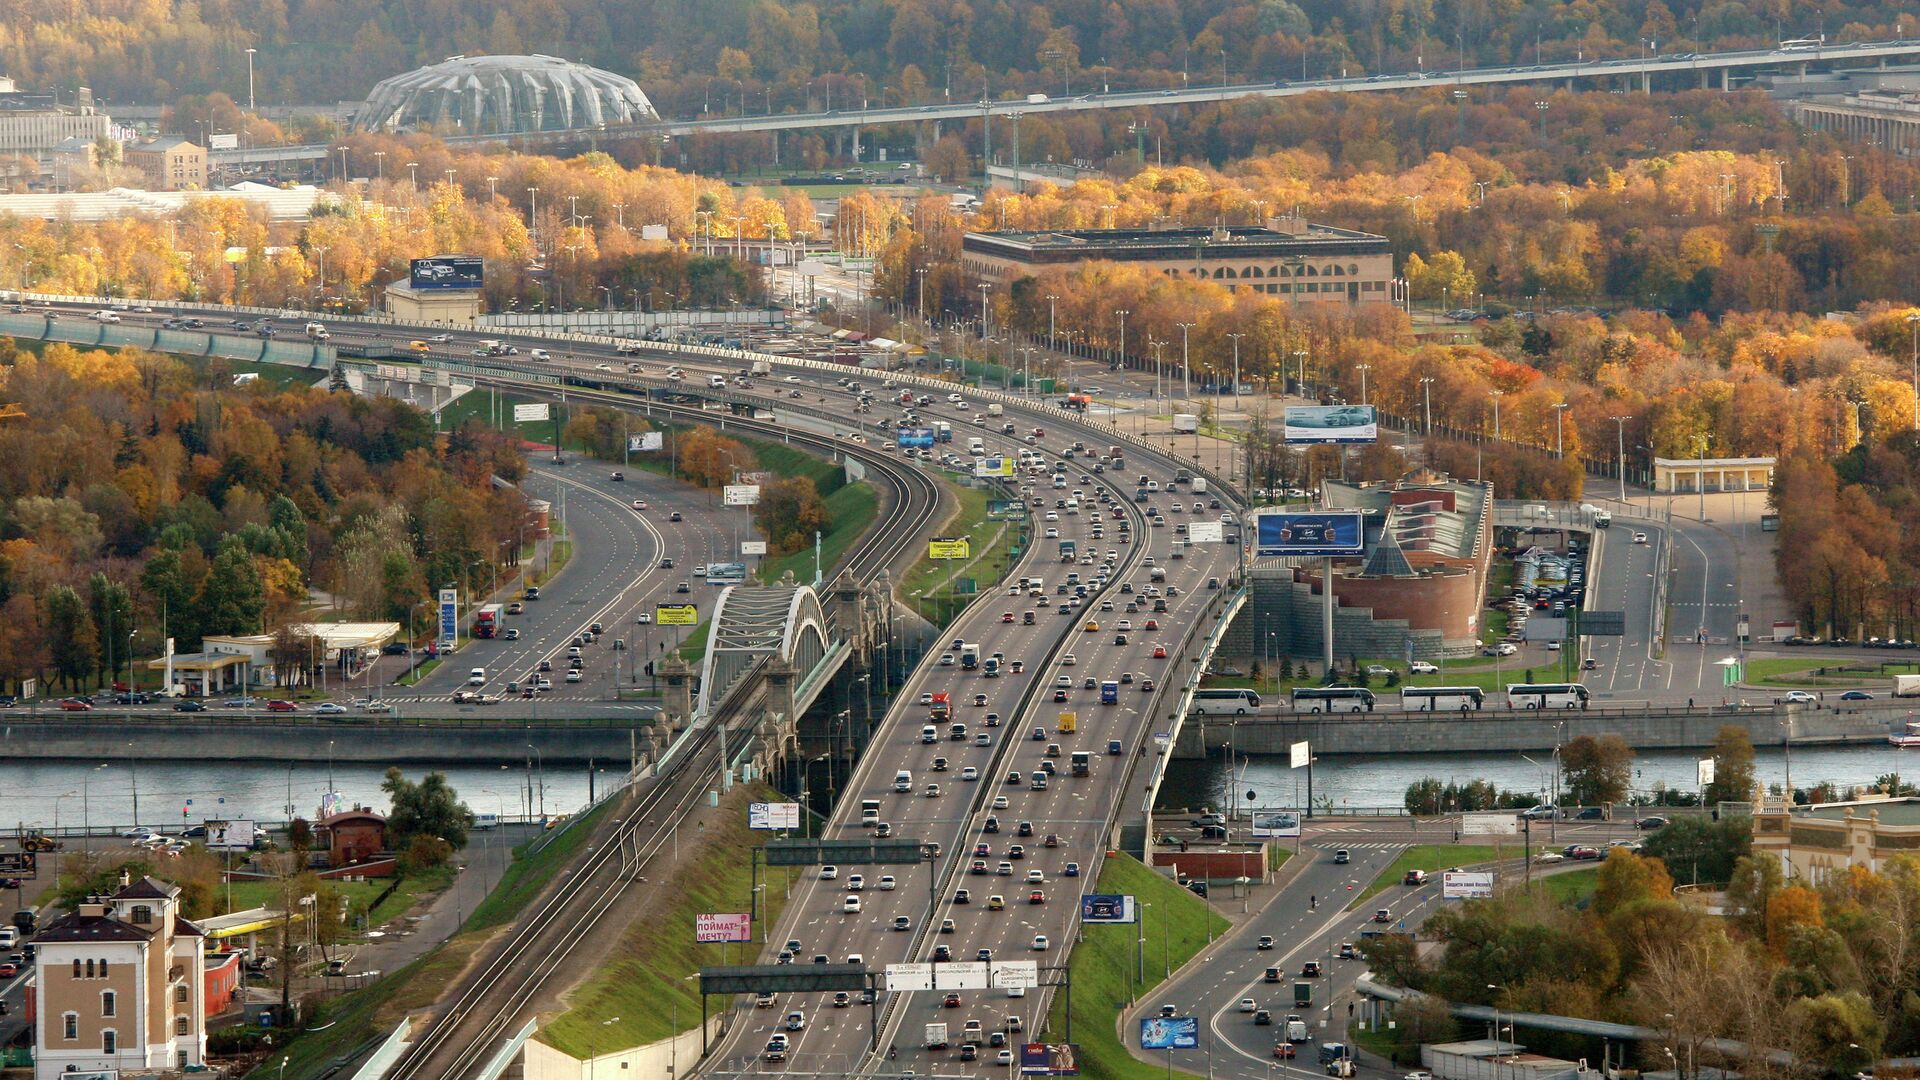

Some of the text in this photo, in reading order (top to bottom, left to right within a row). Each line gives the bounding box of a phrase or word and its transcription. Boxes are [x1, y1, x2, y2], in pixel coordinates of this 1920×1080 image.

[697, 913, 715, 921] КАК
[697, 922, 741, 931] ПОЙМАТЬ
[698, 932, 732, 940] МЕЧТУ?
